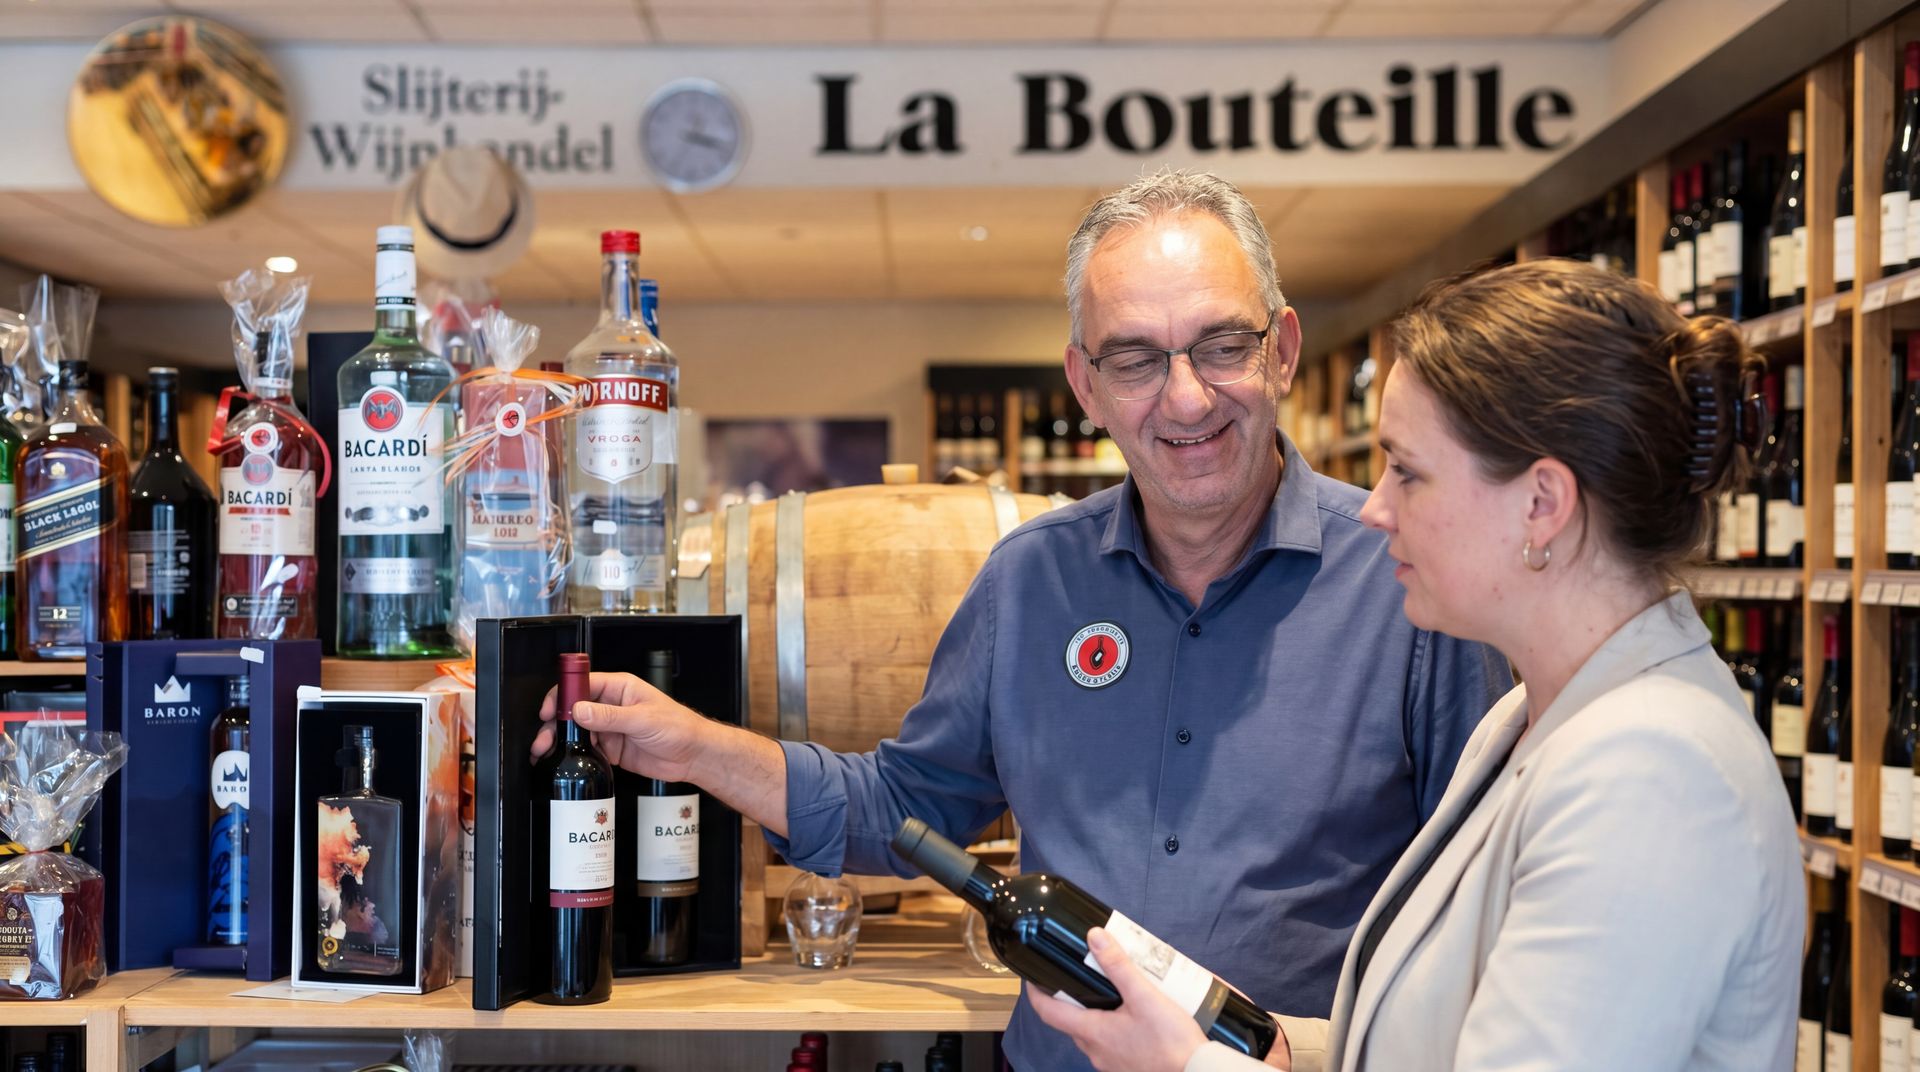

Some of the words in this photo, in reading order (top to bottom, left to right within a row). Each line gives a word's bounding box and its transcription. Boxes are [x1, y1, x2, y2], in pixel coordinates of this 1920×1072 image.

[813, 71, 967, 155] La
[1013, 63, 1577, 156] Bouteille
[309, 122, 614, 182] Wijnndel
[345, 434, 428, 458] BACARDÍ
[228, 487, 292, 505] BACARDÍ
[144, 706, 201, 718] BARON
